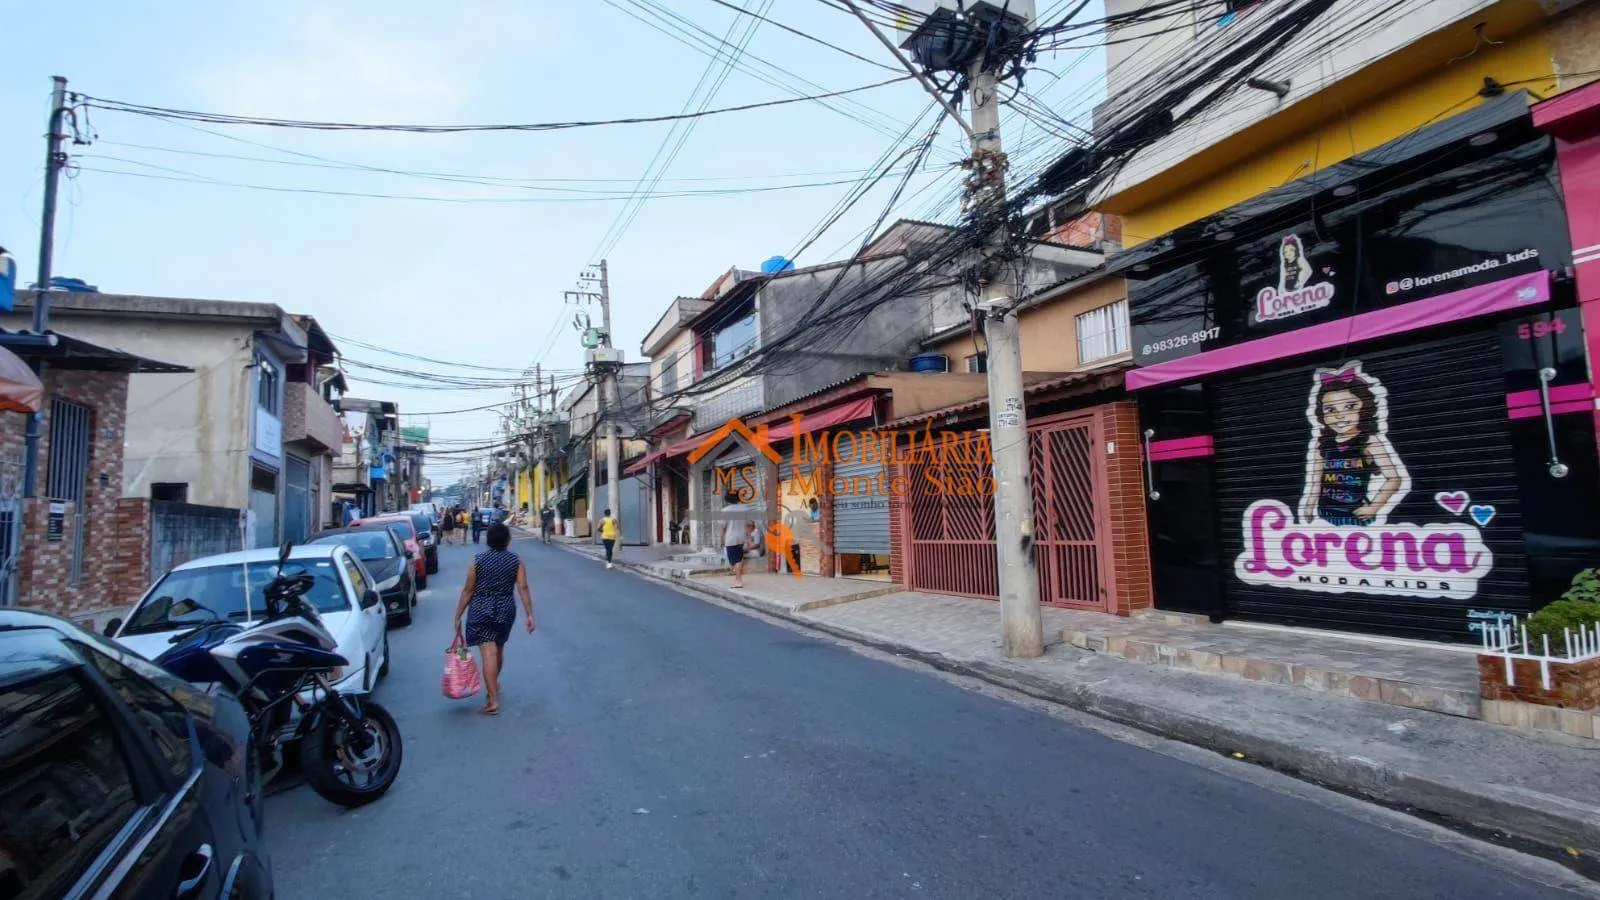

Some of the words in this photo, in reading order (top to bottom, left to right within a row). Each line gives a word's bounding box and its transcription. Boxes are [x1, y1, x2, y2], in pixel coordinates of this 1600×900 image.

[1259, 286, 1330, 320] Lorena
[1152, 327, 1220, 353] 98326-8917
[1244, 505, 1482, 578] Lorena
[1298, 575, 1371, 588] MODA
[1384, 579, 1452, 591] KIDS
